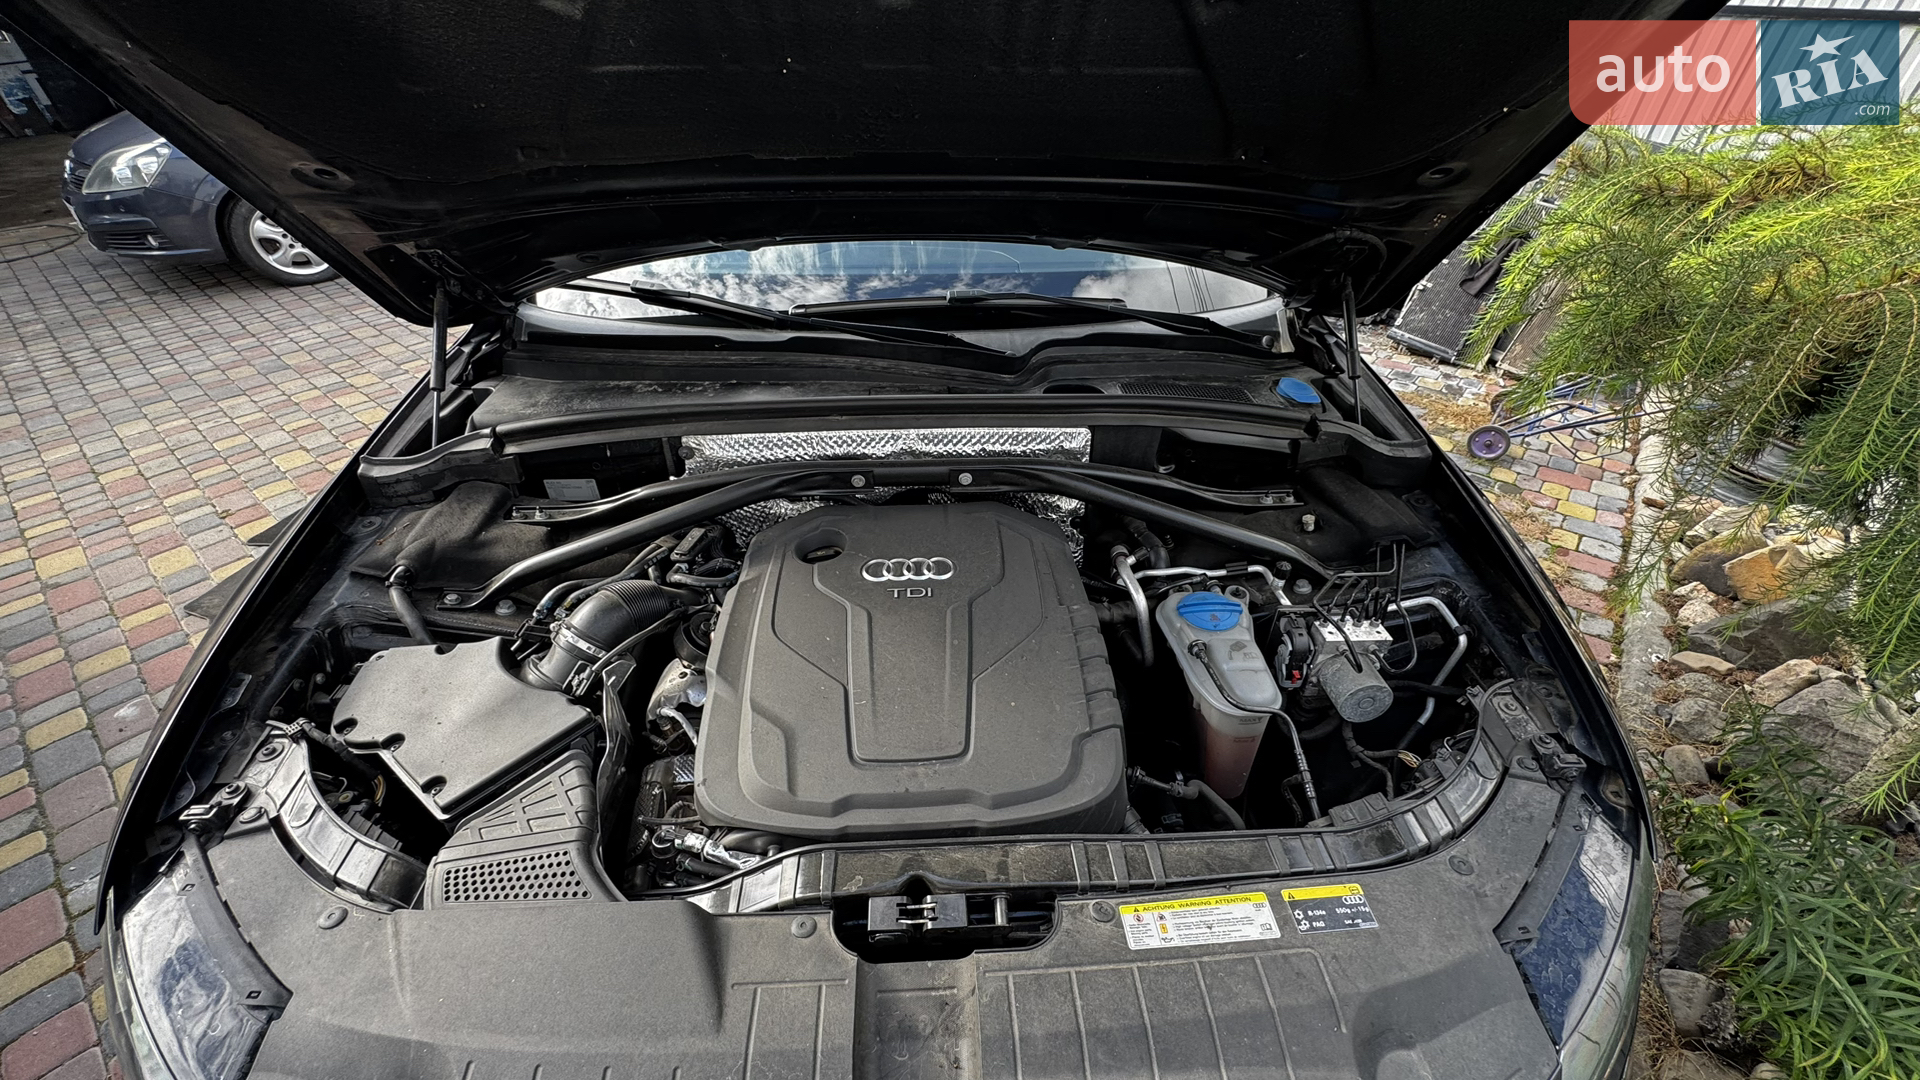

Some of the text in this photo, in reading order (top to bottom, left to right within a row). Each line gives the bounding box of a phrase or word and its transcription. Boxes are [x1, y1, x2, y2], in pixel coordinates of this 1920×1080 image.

[886, 587, 932, 599] TDI
[1142, 896, 1252, 912] ACHTUNG WARNING ATTENTION
